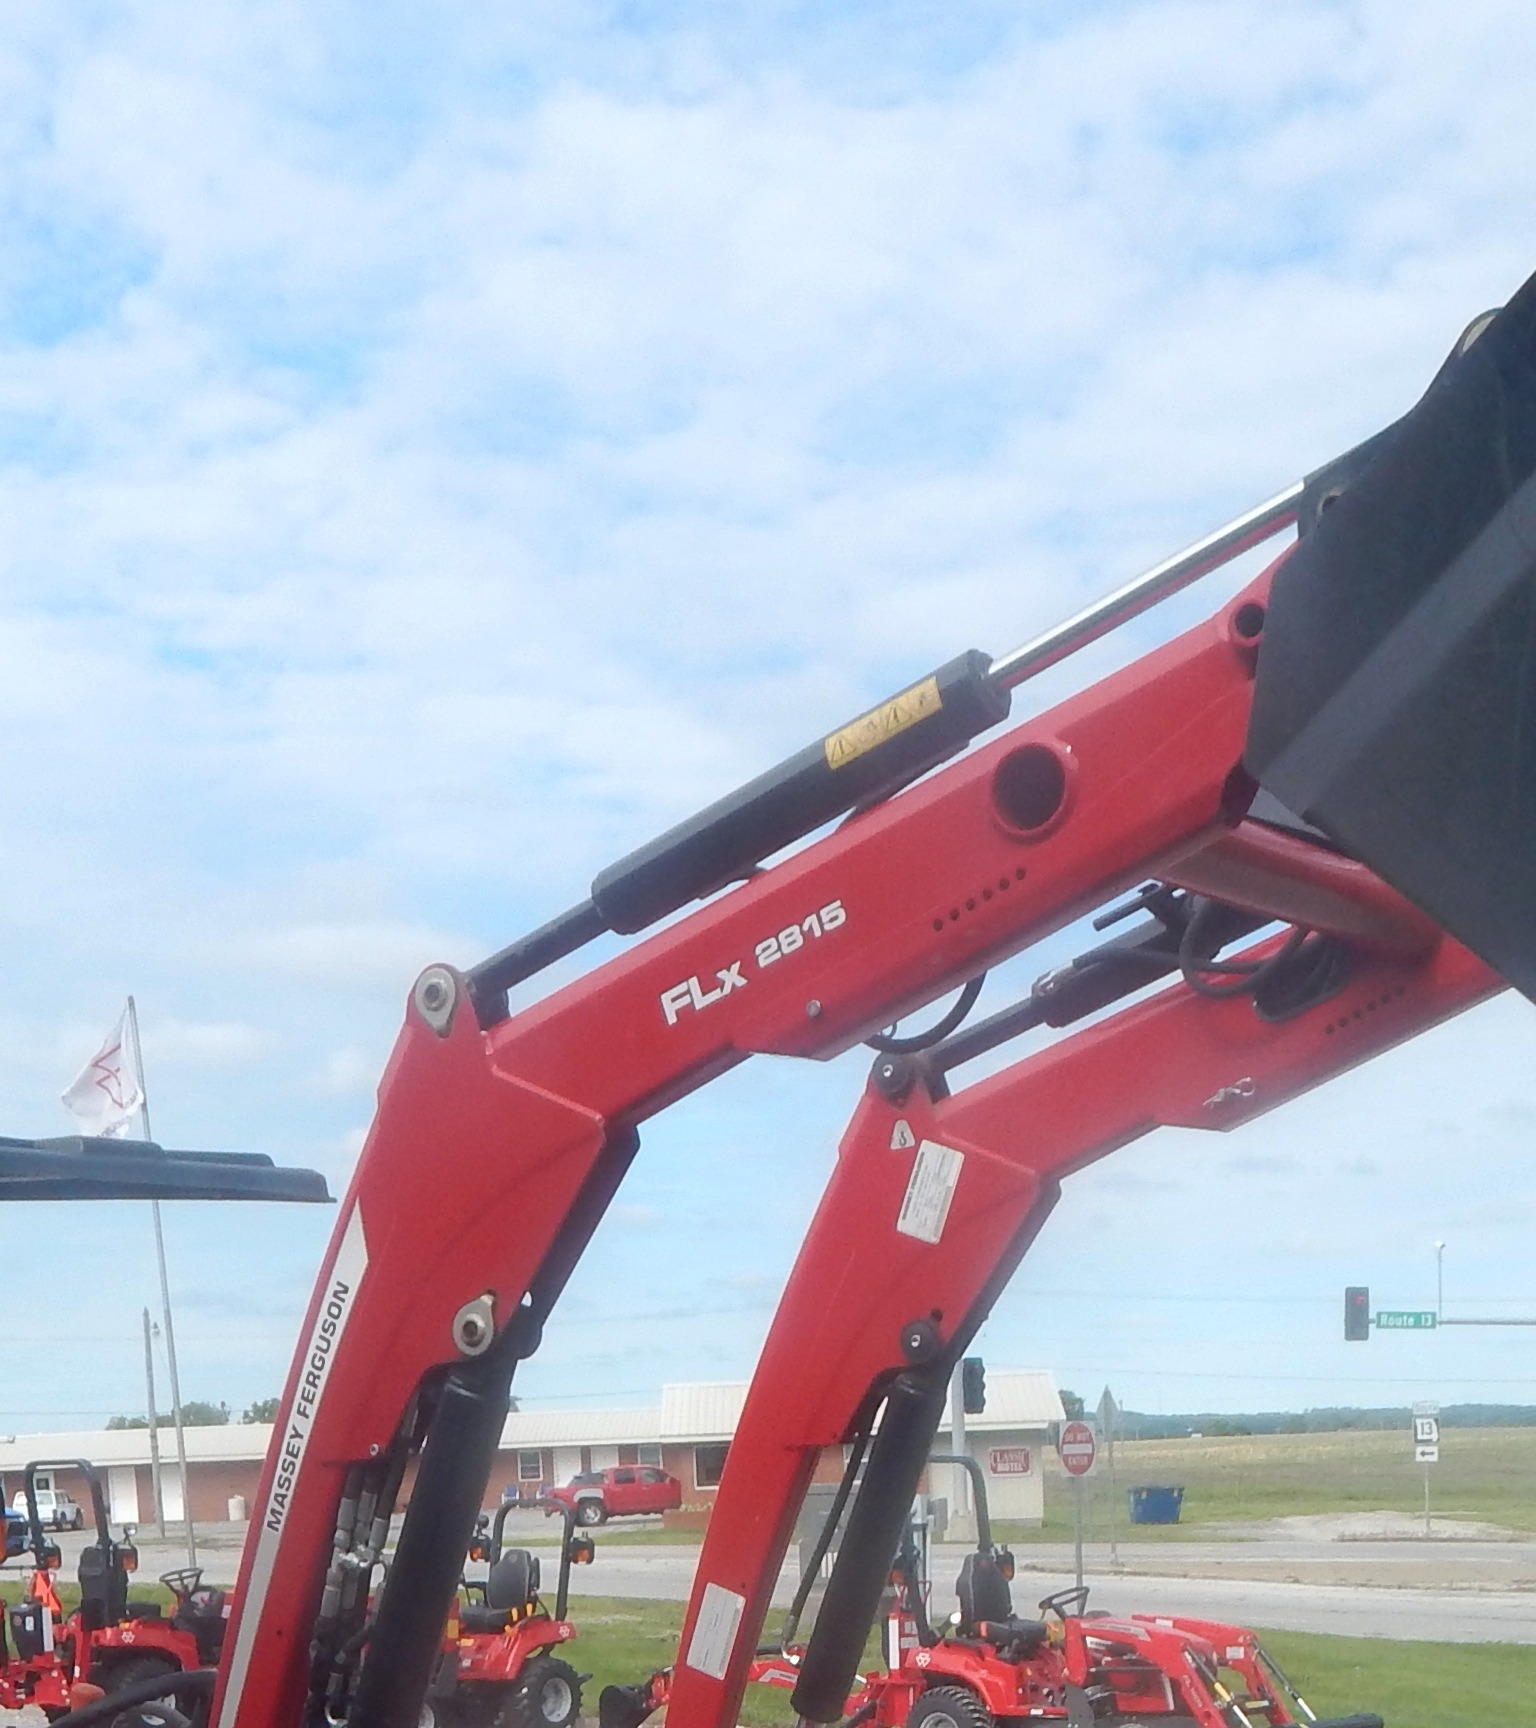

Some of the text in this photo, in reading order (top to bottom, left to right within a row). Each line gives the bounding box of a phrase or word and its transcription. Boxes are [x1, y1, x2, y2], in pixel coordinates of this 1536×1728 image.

[754, 899, 847, 969] 2815
[1379, 1313, 1433, 1327] Route 13
[266, 1280, 350, 1533] MASSEY FERGUSON
[1420, 1421, 1434, 1436] 13
